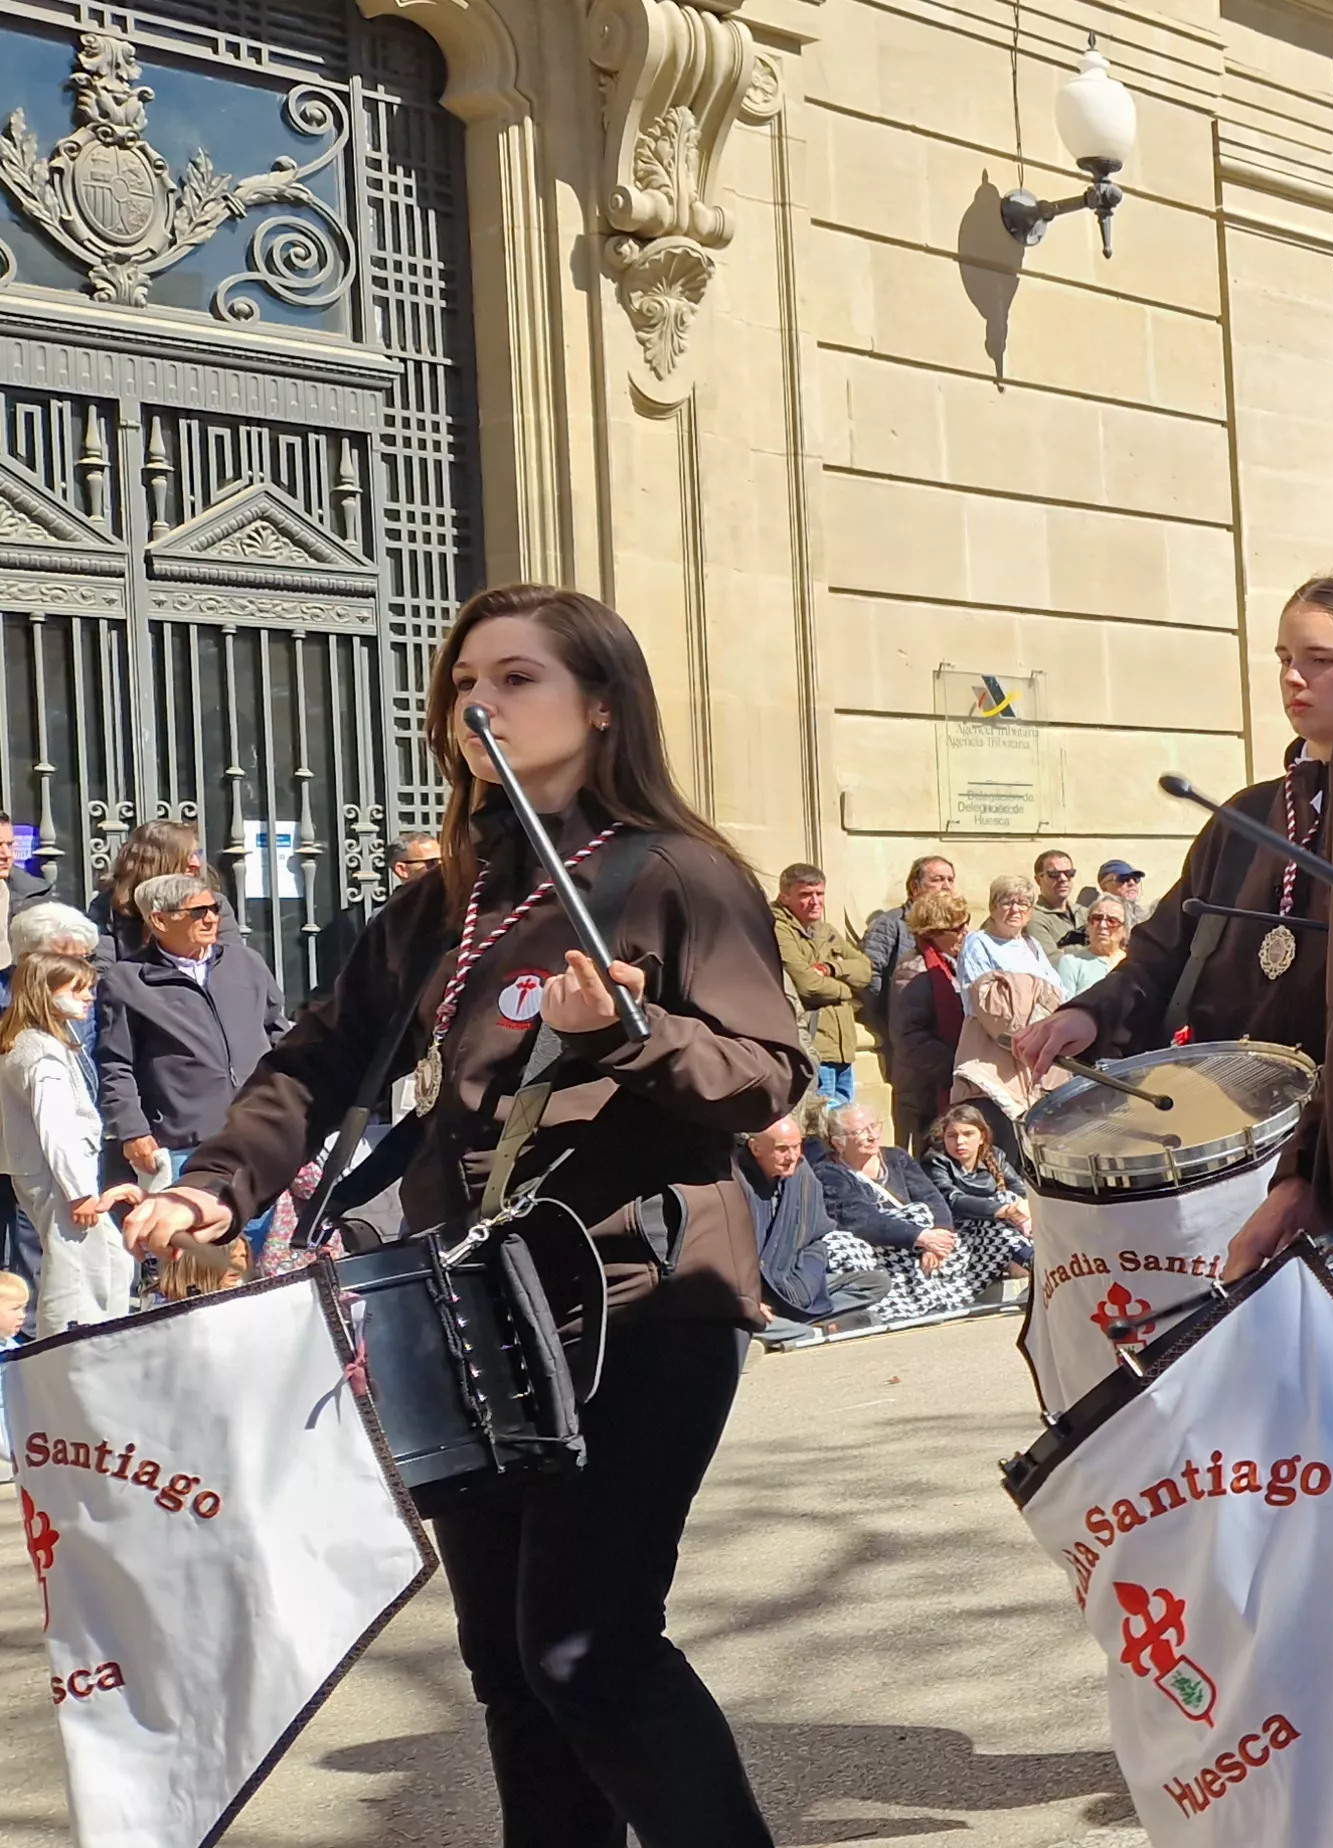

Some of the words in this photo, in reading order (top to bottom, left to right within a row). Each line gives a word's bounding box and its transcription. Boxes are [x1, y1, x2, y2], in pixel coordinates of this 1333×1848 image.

[1118, 1250, 1224, 1280] Santi
[25, 1431, 222, 1520] Santiago
[1085, 1449, 1332, 1548] Santiago
[1162, 1713, 1302, 1820] Huesca
